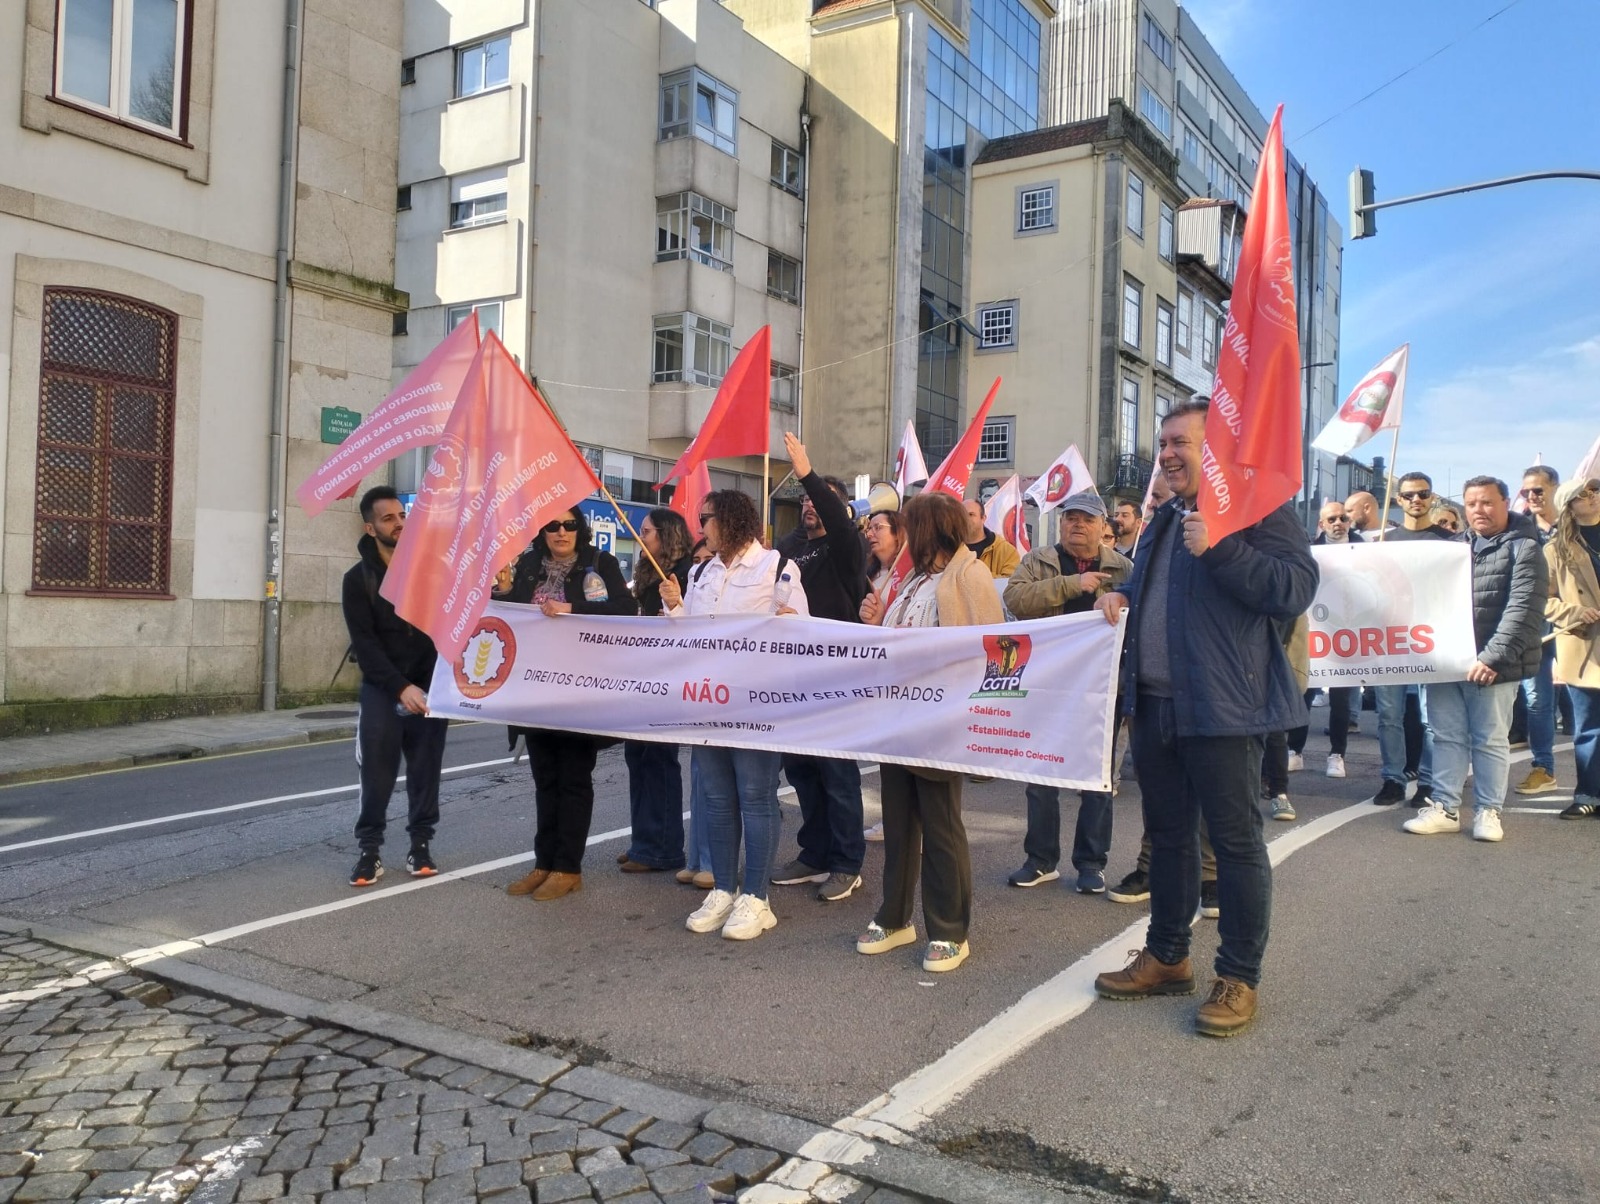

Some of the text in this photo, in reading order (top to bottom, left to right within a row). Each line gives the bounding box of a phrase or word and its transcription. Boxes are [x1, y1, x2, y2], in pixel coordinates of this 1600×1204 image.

[578, 632, 888, 659] TRABALHADORES DA ALIMENTAÇÃO E BEBIDAS EM LUTA
[1322, 669, 1327, 677] E
[1328, 667, 1370, 677] TABACOS
[1372, 667, 1384, 675] DE
[524, 669, 945, 704] DIREITOS CONQUISTADOS NÃO PODEM SER RETIRADOS
[982, 677, 1020, 691] CGTP
[720, 721, 734, 729] NO
[735, 721, 776, 732] STIANOR!
[1026, 750, 1065, 764] Colectiva
